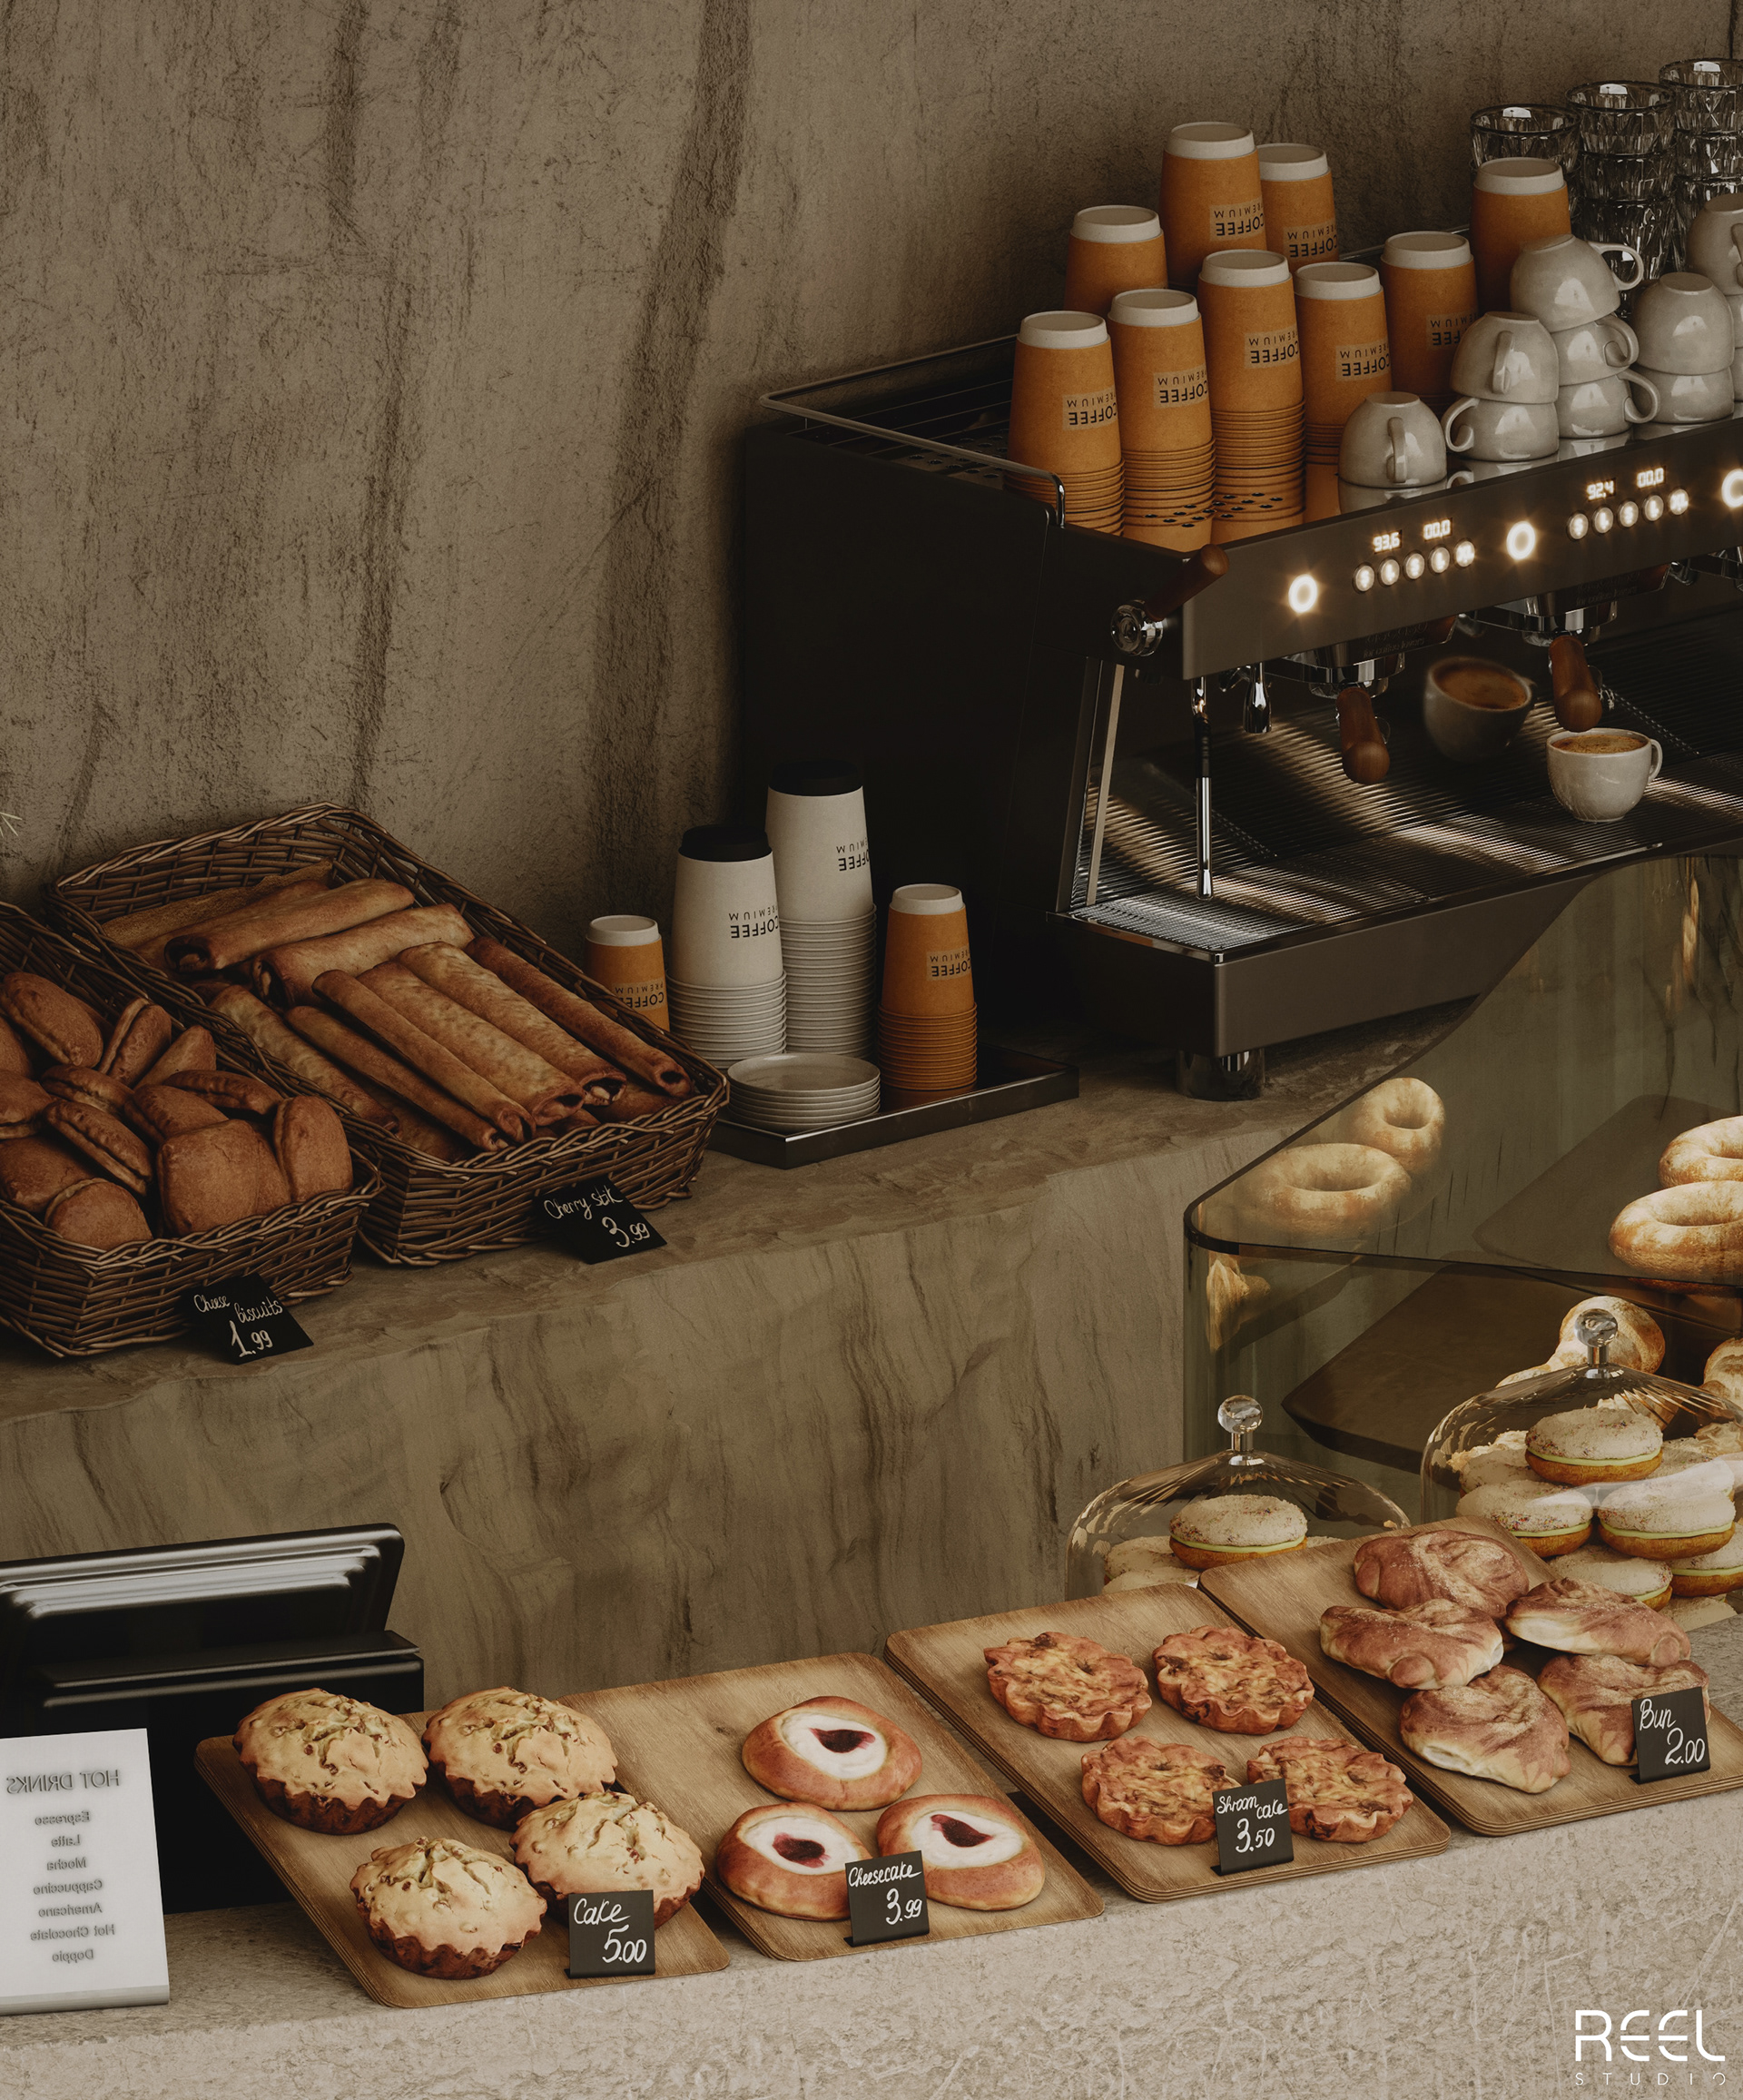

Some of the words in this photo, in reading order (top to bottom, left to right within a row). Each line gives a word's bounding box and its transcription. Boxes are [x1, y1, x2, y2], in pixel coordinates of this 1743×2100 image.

[1432, 330, 1462, 346] FEE
[619, 991, 665, 1008] COFFE
[544, 1198, 592, 1220] Cherry
[602, 1217, 651, 1247] 3.99
[193, 1294, 231, 1313] Cheese
[234, 1296, 283, 1324] biscuits
[229, 1320, 273, 1357] 1.99
[1640, 1698, 1677, 1731] Bun
[1665, 1727, 1706, 1765] 2.00
[1216, 1795, 1260, 1814] Shroom
[1256, 1799, 1288, 1819] cake
[1236, 1818, 1275, 1853] 3.50
[848, 1860, 922, 1888] Cheesecake
[574, 1898, 632, 1925] Cake
[886, 1888, 923, 1925] 3.99
[602, 1924, 647, 1964] 5.00
